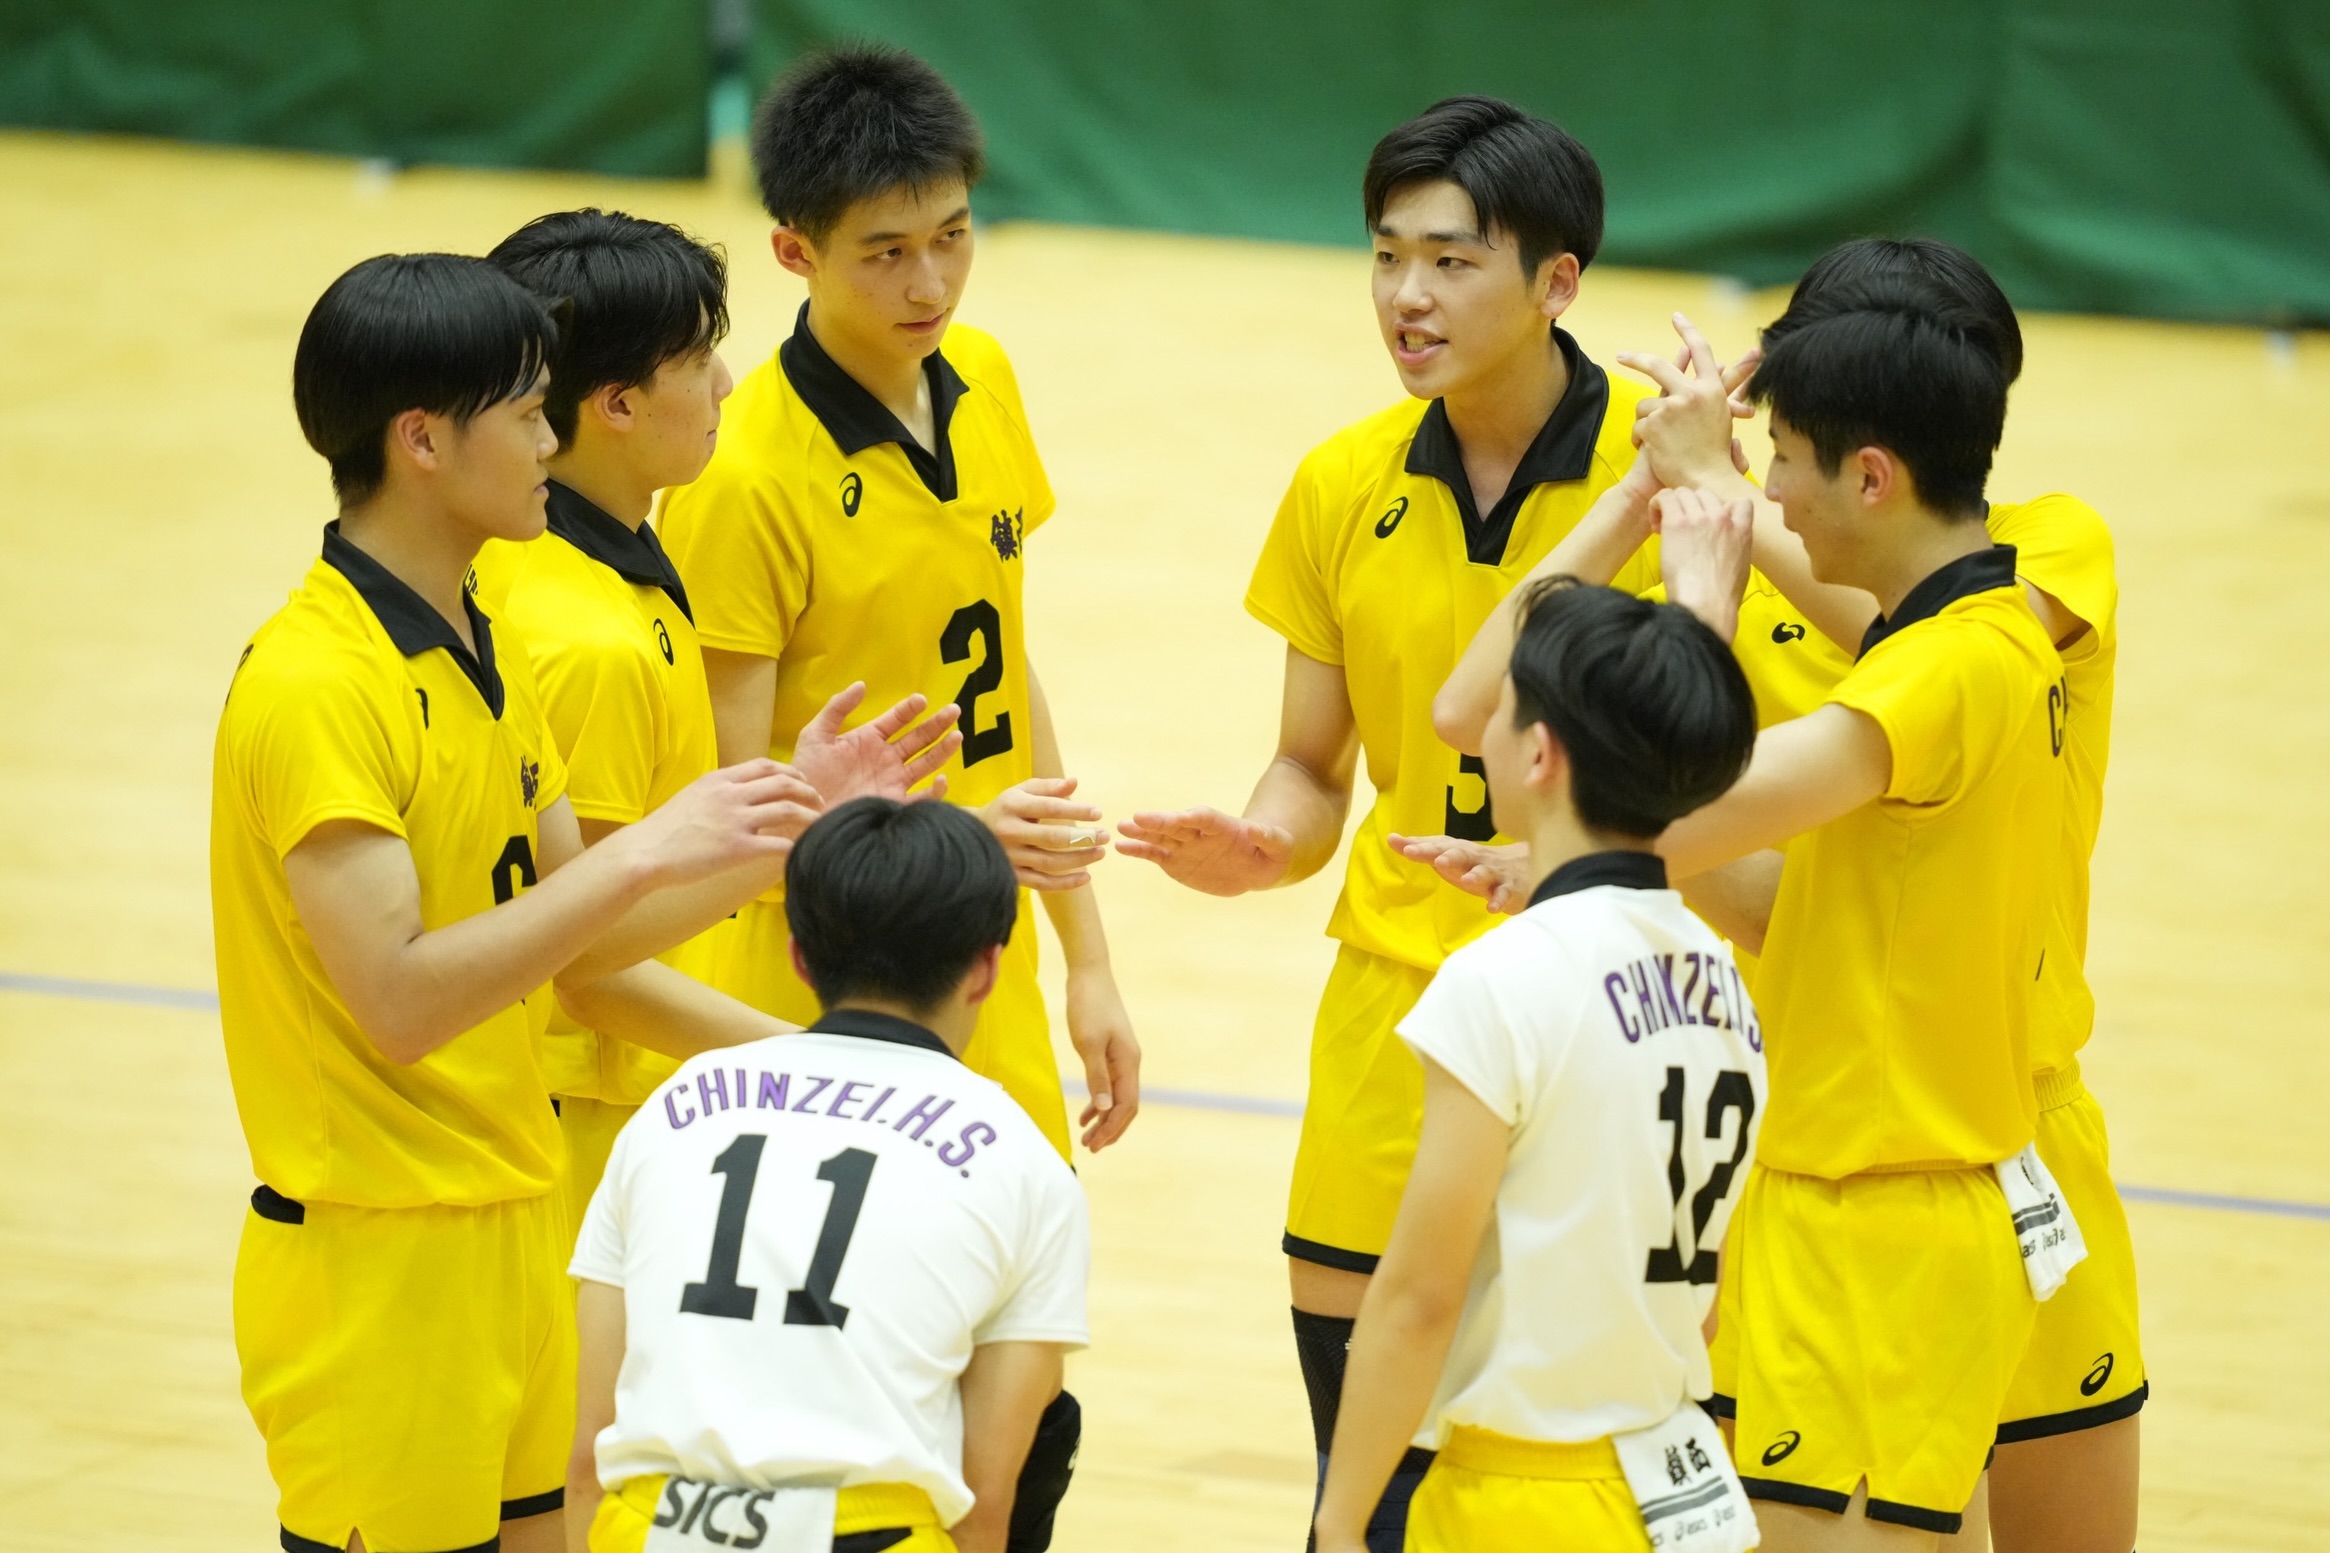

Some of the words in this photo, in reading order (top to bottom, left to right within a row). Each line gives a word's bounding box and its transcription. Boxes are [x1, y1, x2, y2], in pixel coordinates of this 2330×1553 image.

[939, 599, 1014, 769] 2
[679, 1134, 878, 1331] 11
[1644, 1066, 1755, 1286] 12
